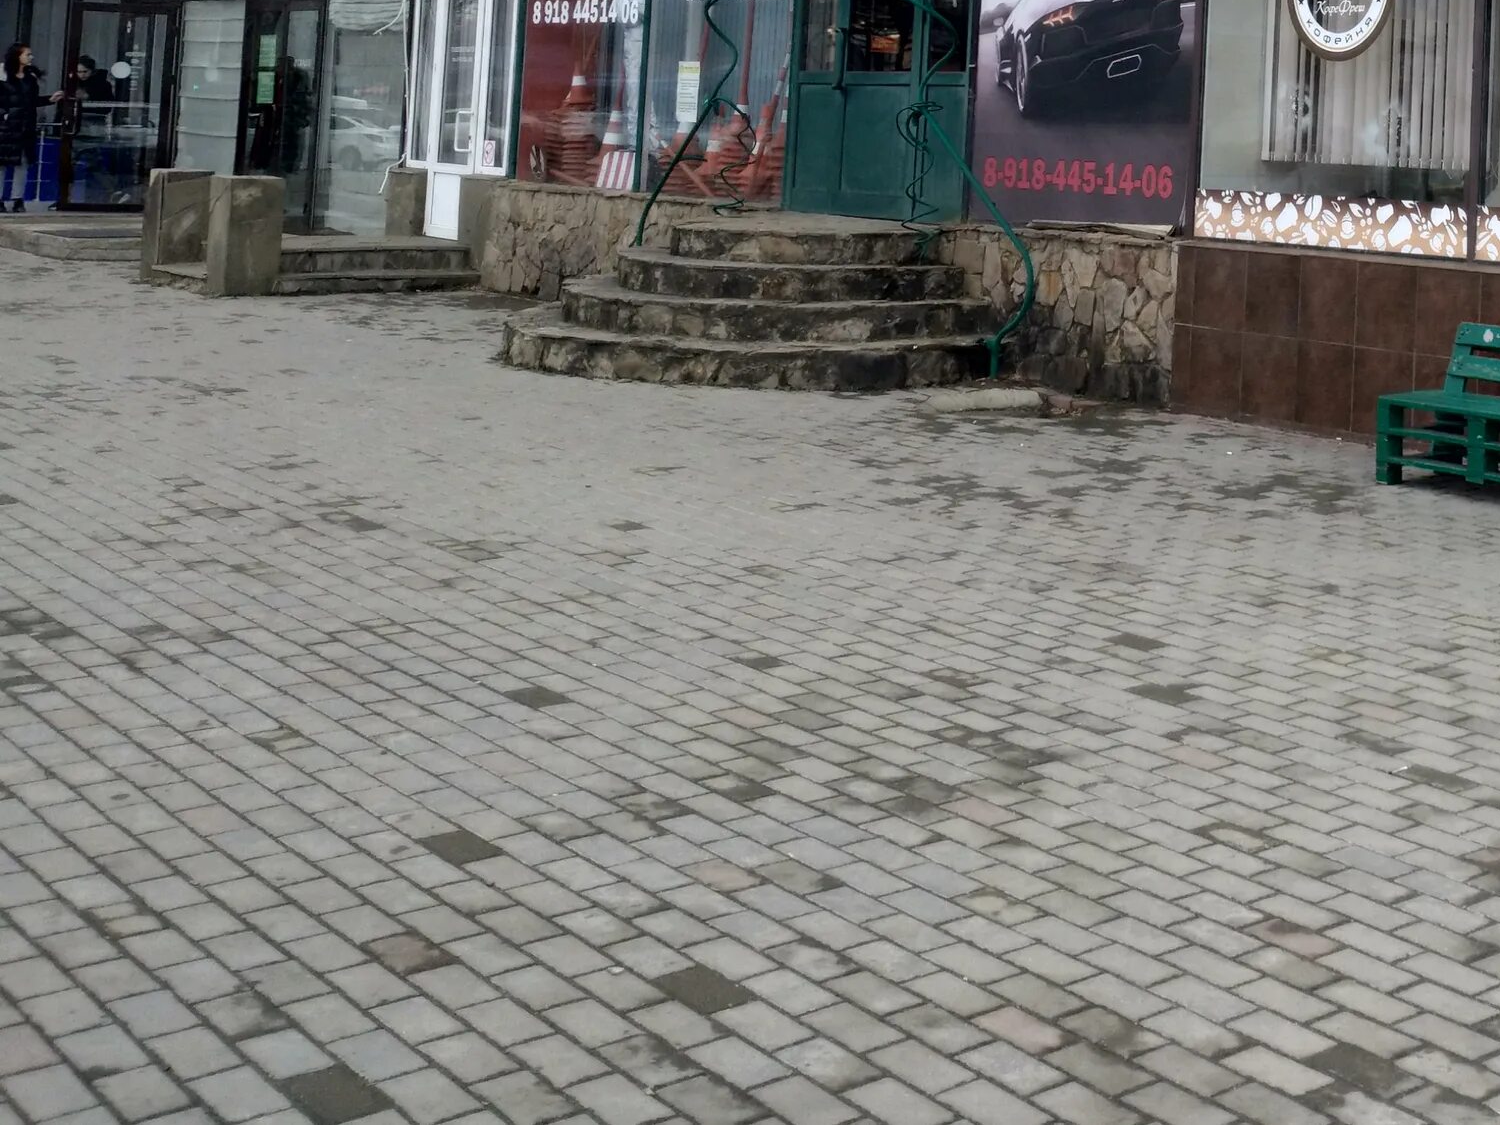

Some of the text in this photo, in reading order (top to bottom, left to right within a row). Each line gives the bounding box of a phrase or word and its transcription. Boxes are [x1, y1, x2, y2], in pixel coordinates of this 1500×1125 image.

[532, 0, 541, 25] 8
[544, 0, 569, 25] 918
[982, 155, 1174, 200] 8-918-445-14-06
